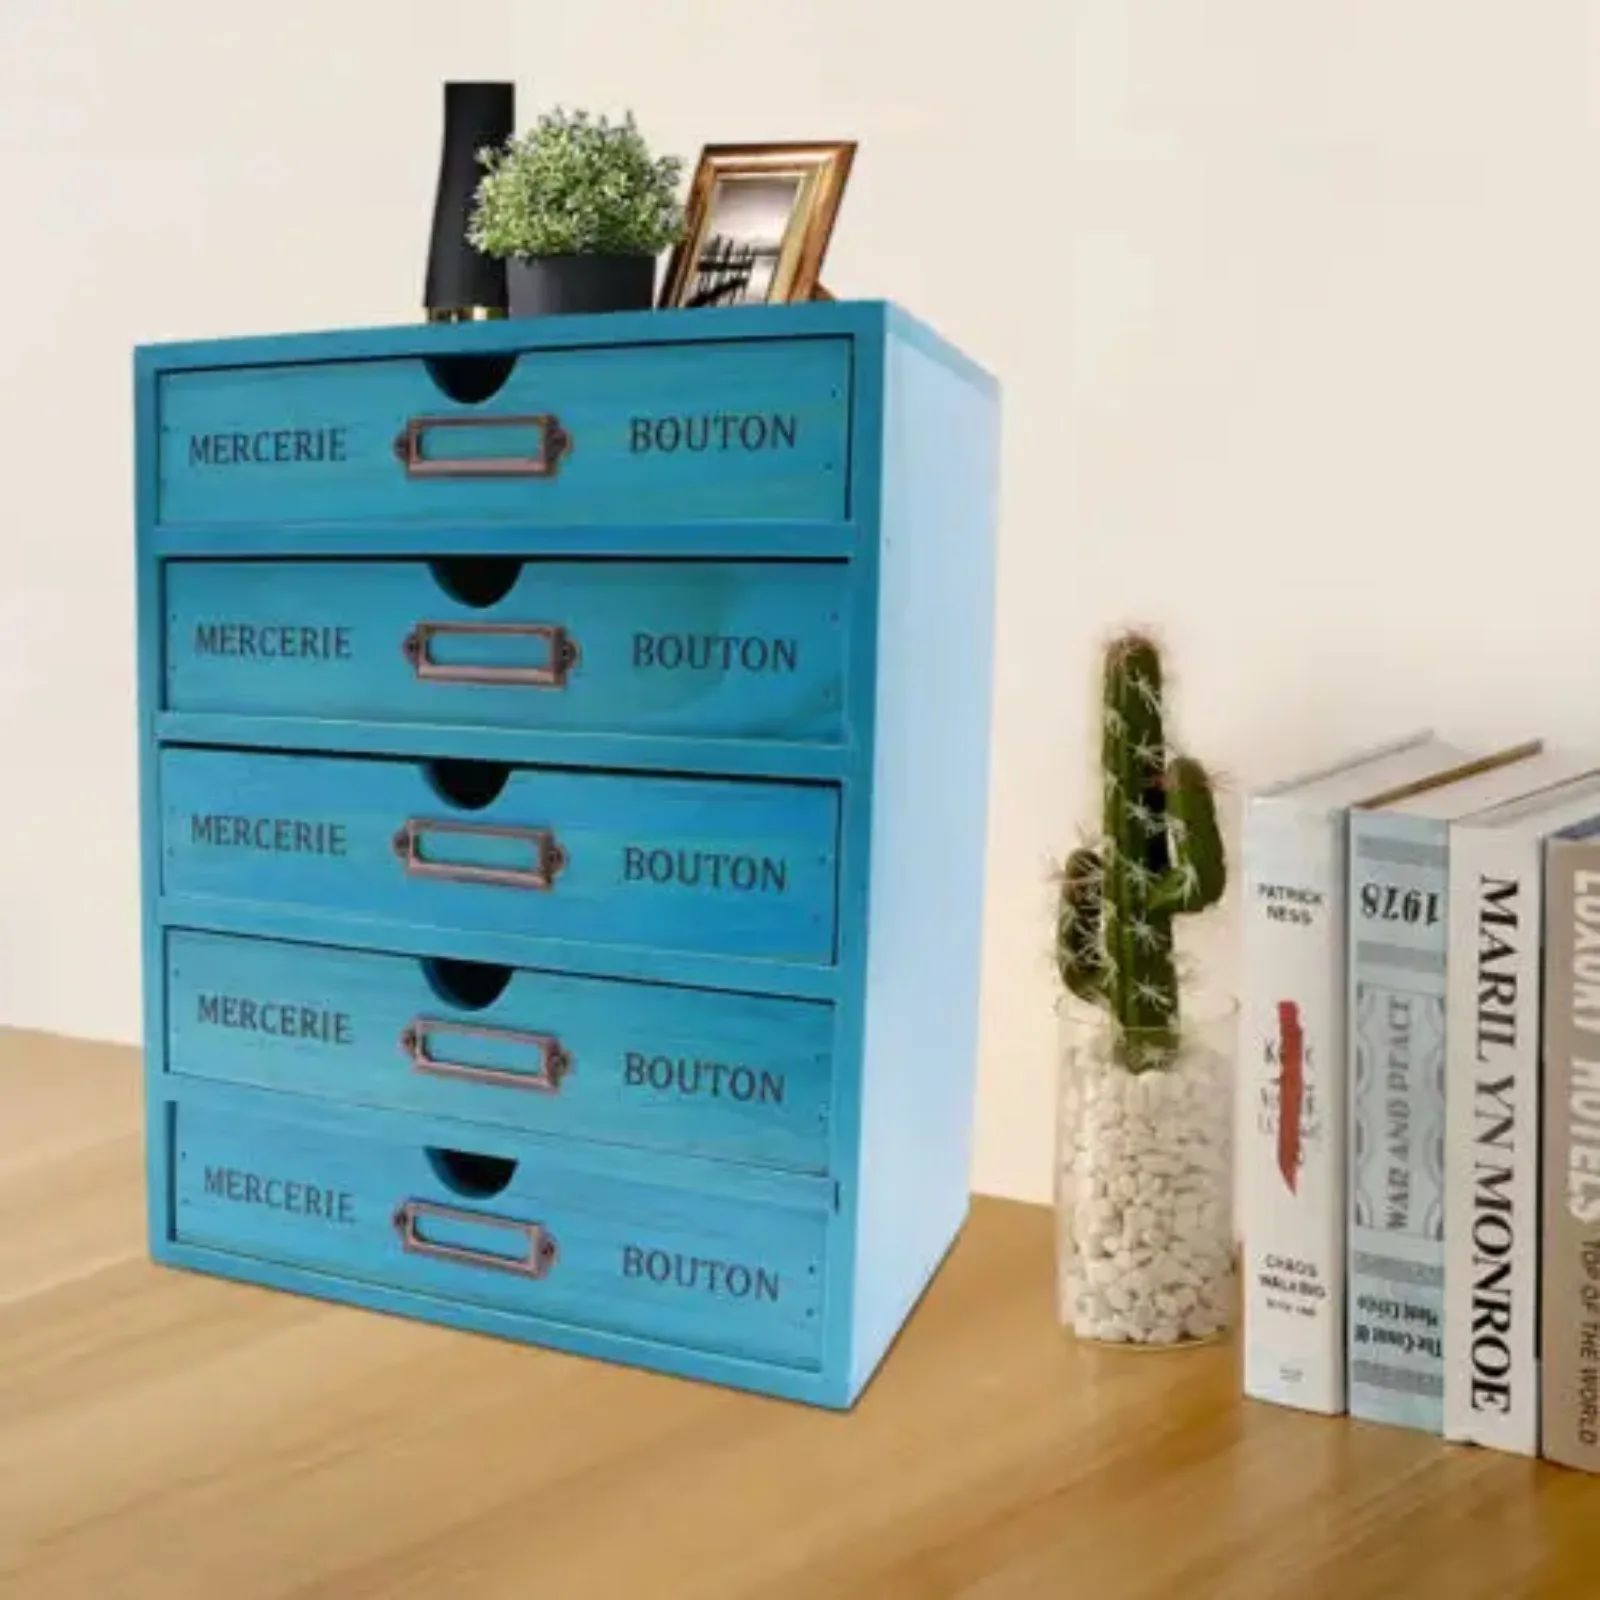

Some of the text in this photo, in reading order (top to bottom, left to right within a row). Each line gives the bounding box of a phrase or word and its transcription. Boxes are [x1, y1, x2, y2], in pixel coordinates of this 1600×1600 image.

[189, 414, 796, 465] MERCERIE BOUTON
[195, 624, 797, 672] MERCERIE BOUTON
[191, 813, 787, 892] MERCERIE BOUTON
[1258, 881, 1323, 904] PATRICK
[1266, 903, 1313, 926] NESS
[1359, 881, 1441, 928] 1978
[197, 994, 785, 1106] MERCERIE BOUTON
[1386, 1098, 1411, 1164] AND
[1470, 872, 1520, 1417] MARILYN MONROE
[1385, 1165, 1410, 1231] WAR
[203, 1165, 780, 1303] MERCERIE BOUTON
[1580, 1283, 1600, 1315] OF
[1580, 1321, 1600, 1359] THE
[1578, 1366, 1600, 1446] WORLD
